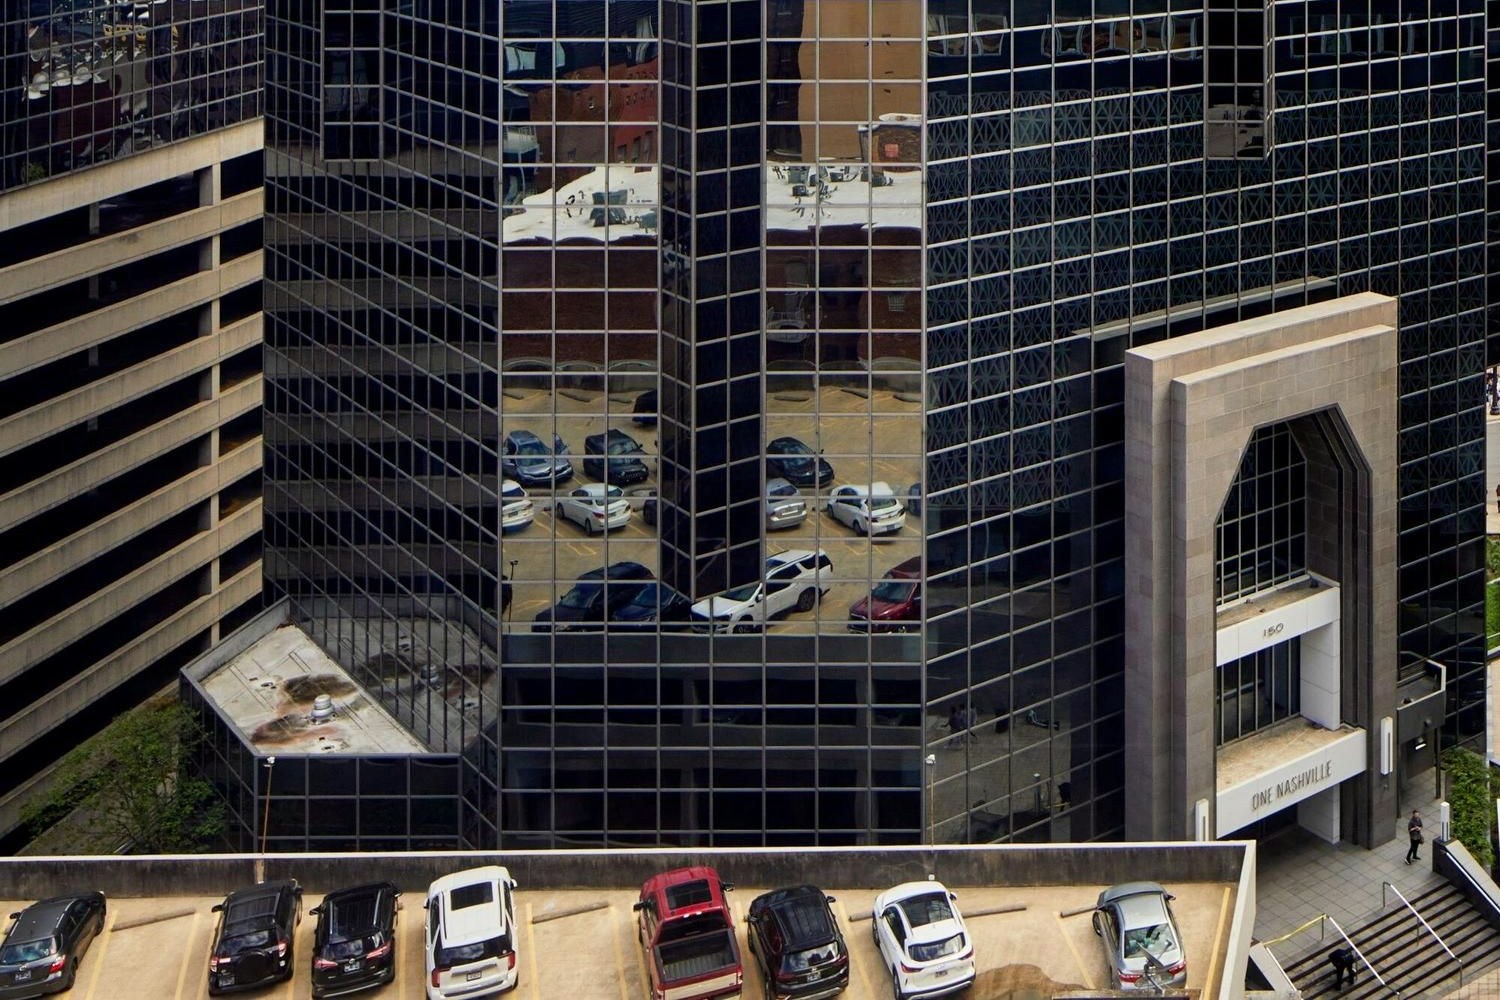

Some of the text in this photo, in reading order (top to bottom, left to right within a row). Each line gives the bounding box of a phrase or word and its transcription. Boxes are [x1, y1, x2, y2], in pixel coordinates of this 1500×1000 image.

[1263, 623, 1284, 637] 150
[1252, 760, 1332, 810] ONE NASHVILLE
